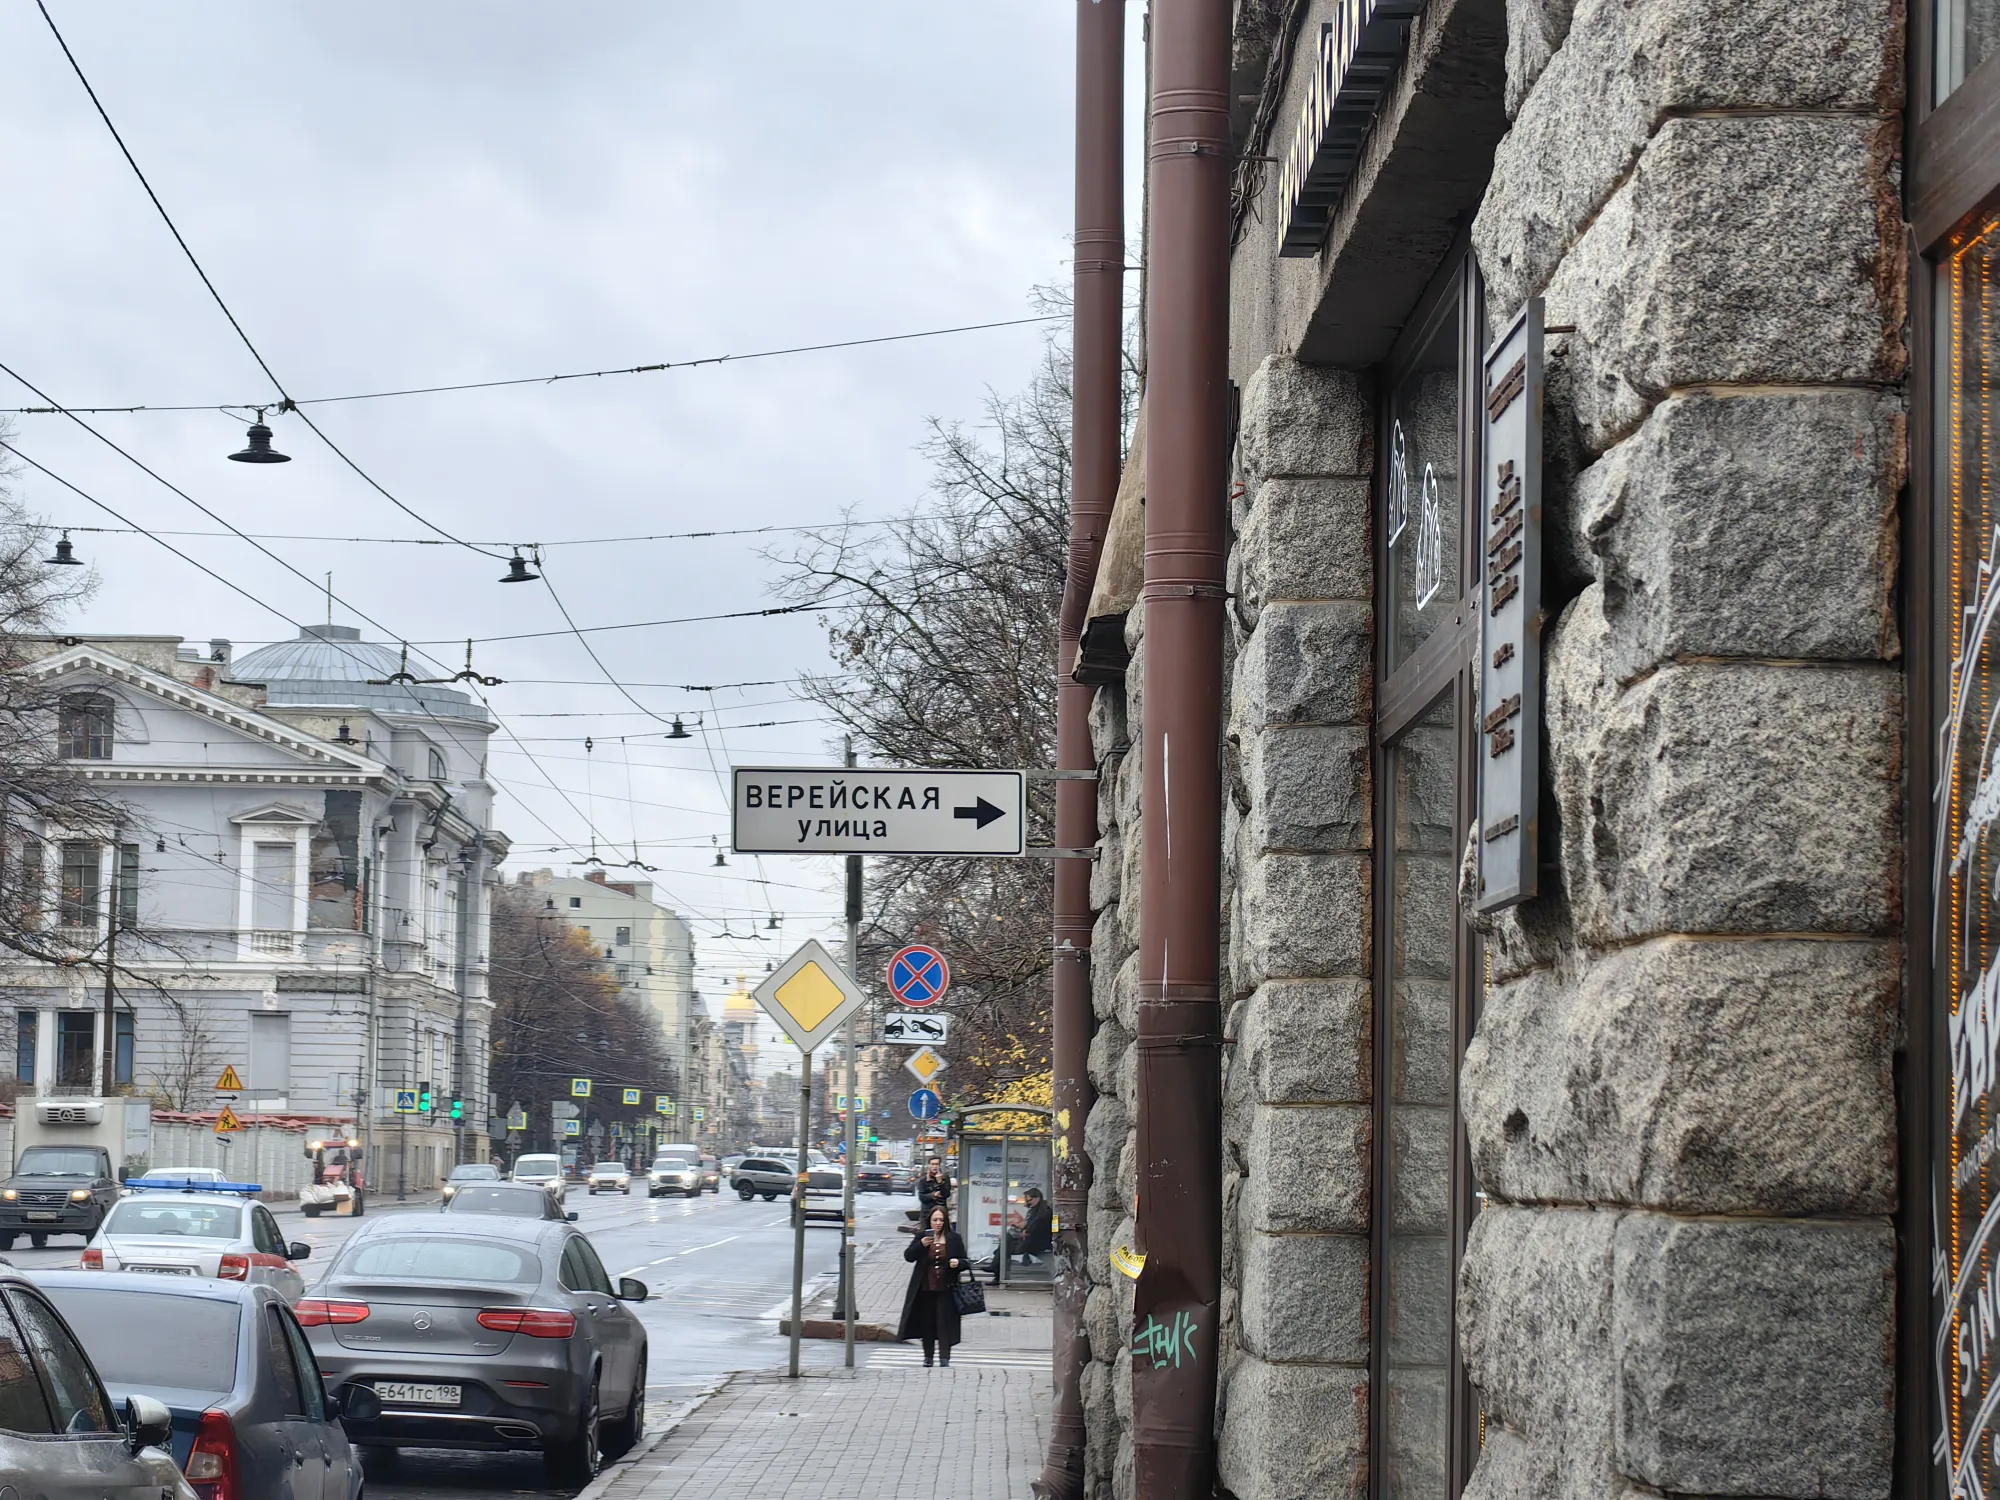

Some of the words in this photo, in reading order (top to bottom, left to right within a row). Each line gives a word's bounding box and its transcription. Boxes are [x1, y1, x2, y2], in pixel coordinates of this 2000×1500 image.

[746, 780, 940, 810] ВЕРЕЙСКАЯ
[798, 819, 887, 843] улица
[436, 1386, 458, 1397] 198
